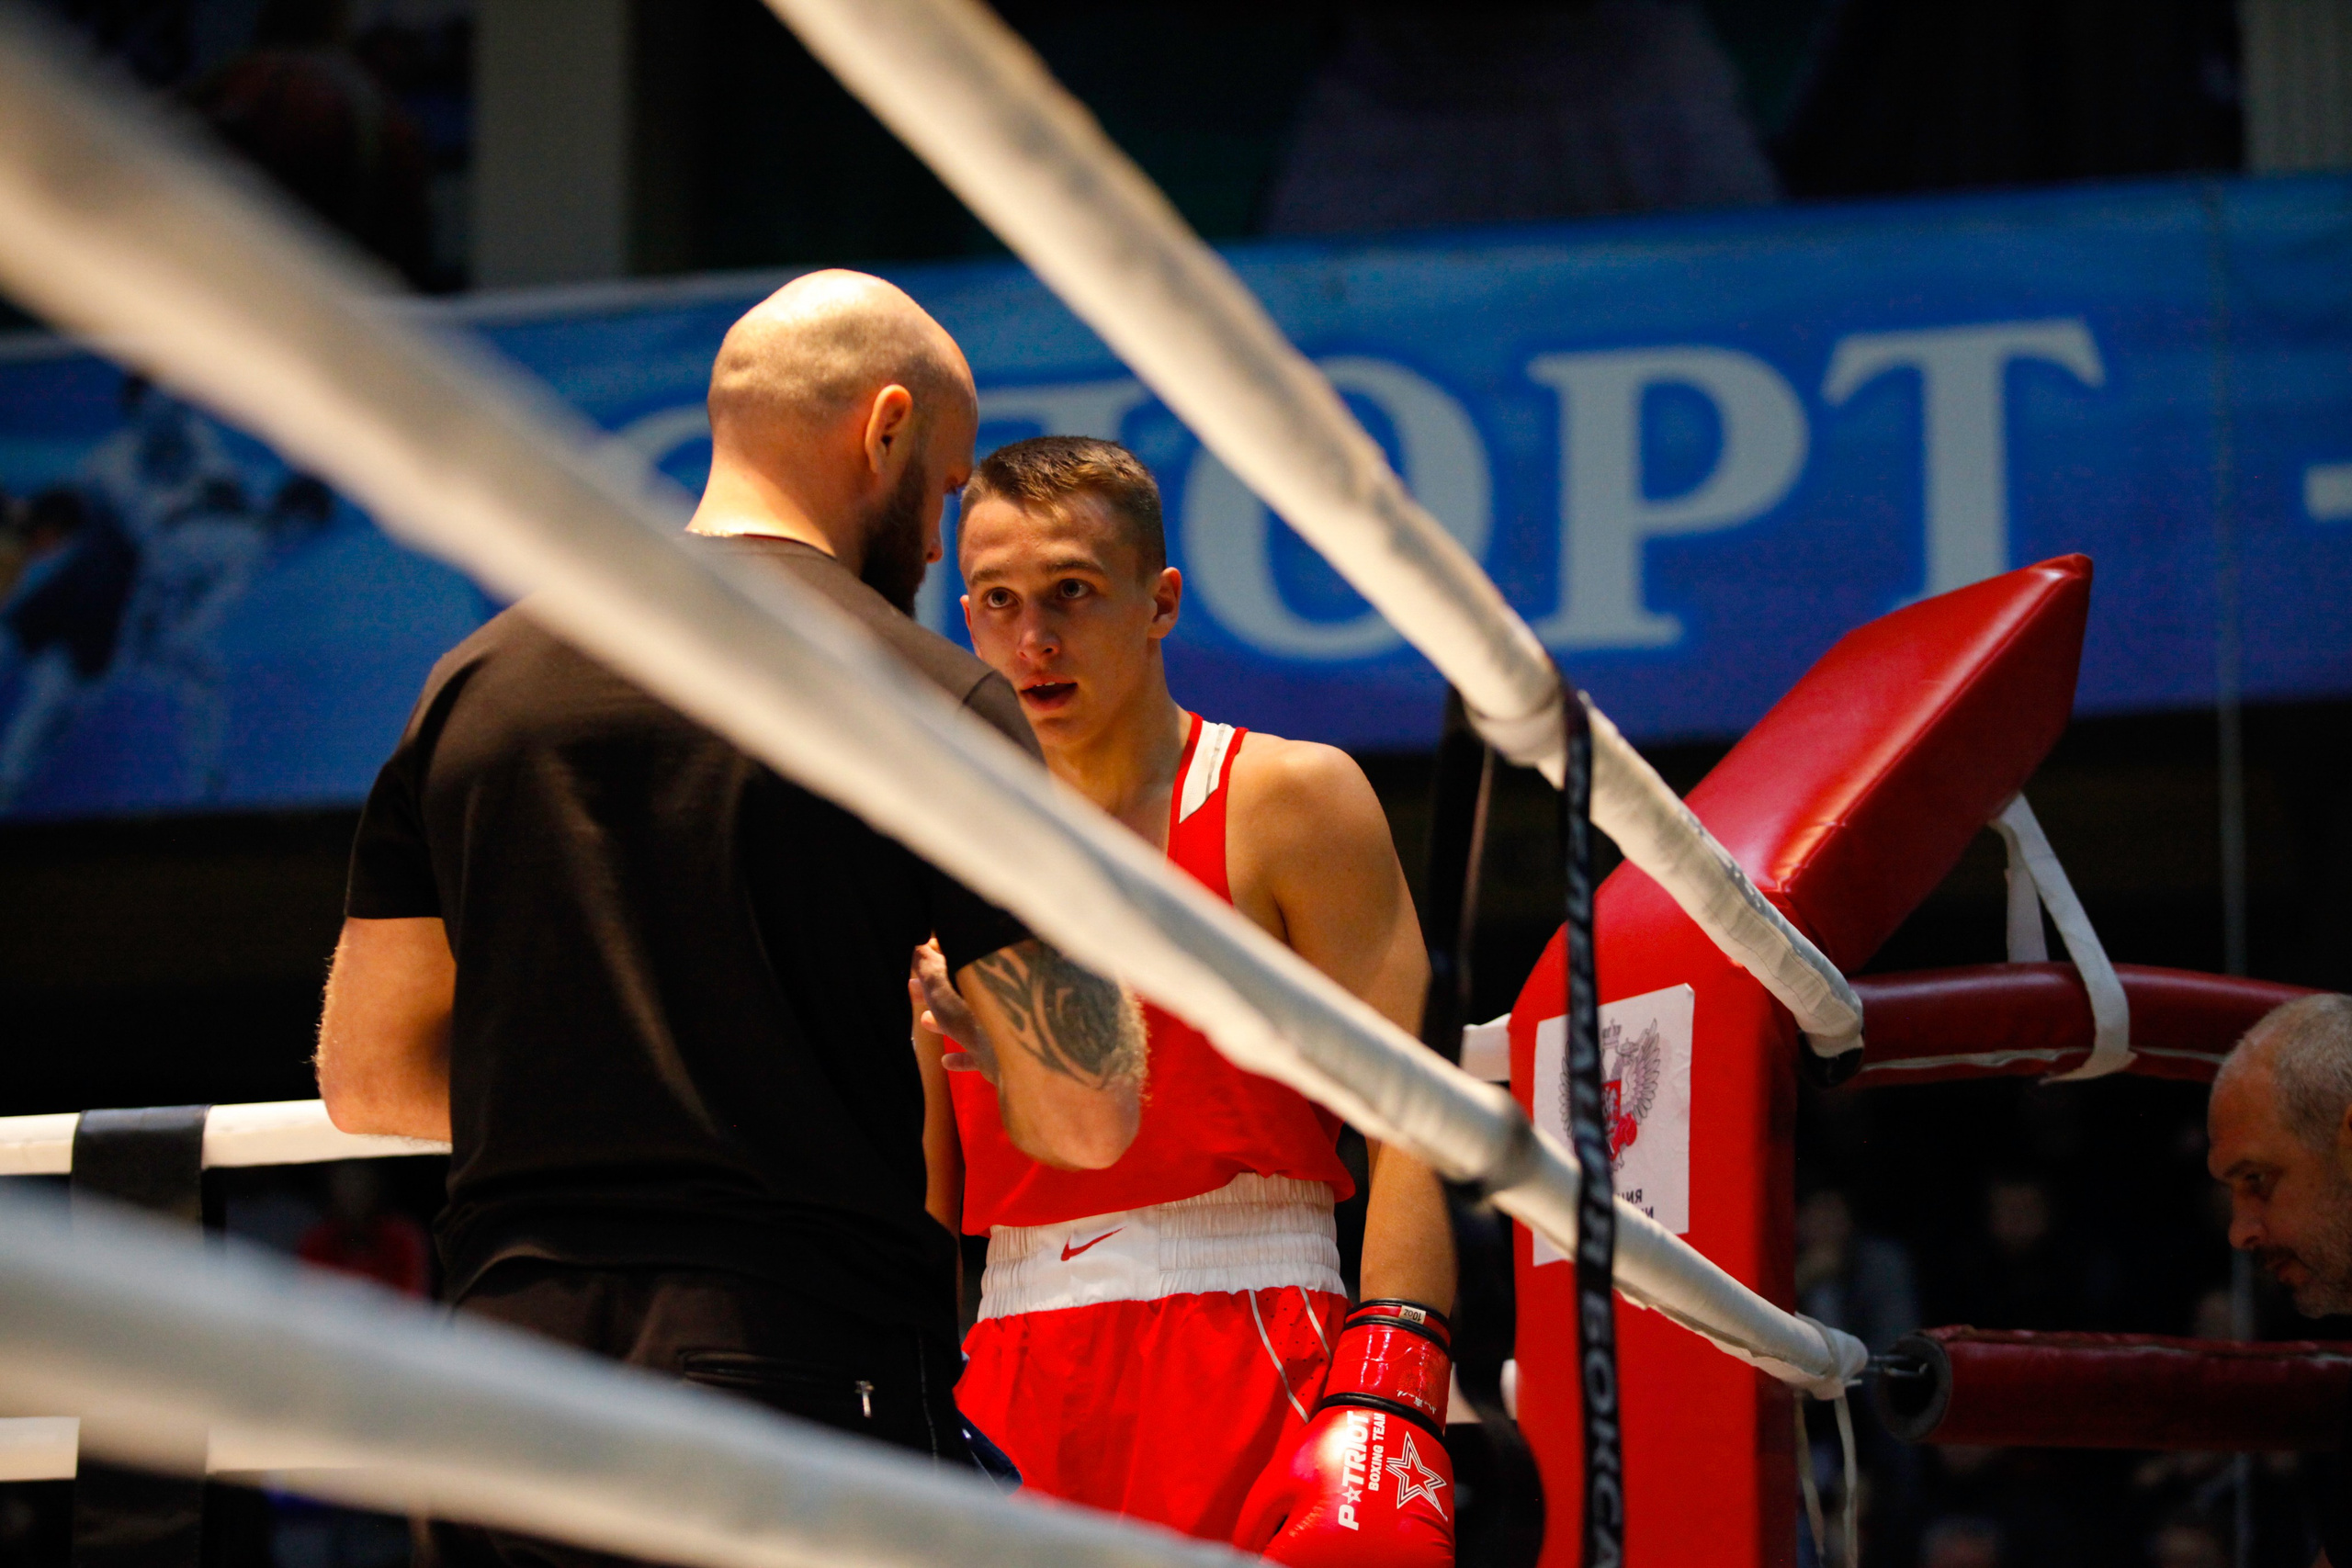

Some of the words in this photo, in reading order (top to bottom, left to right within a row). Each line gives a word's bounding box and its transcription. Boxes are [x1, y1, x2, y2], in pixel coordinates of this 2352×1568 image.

[611, 318, 2107, 663] ОРТ
[1372, 1412, 1386, 1441] TEAM
[1368, 1444, 1384, 1492] BOXING
